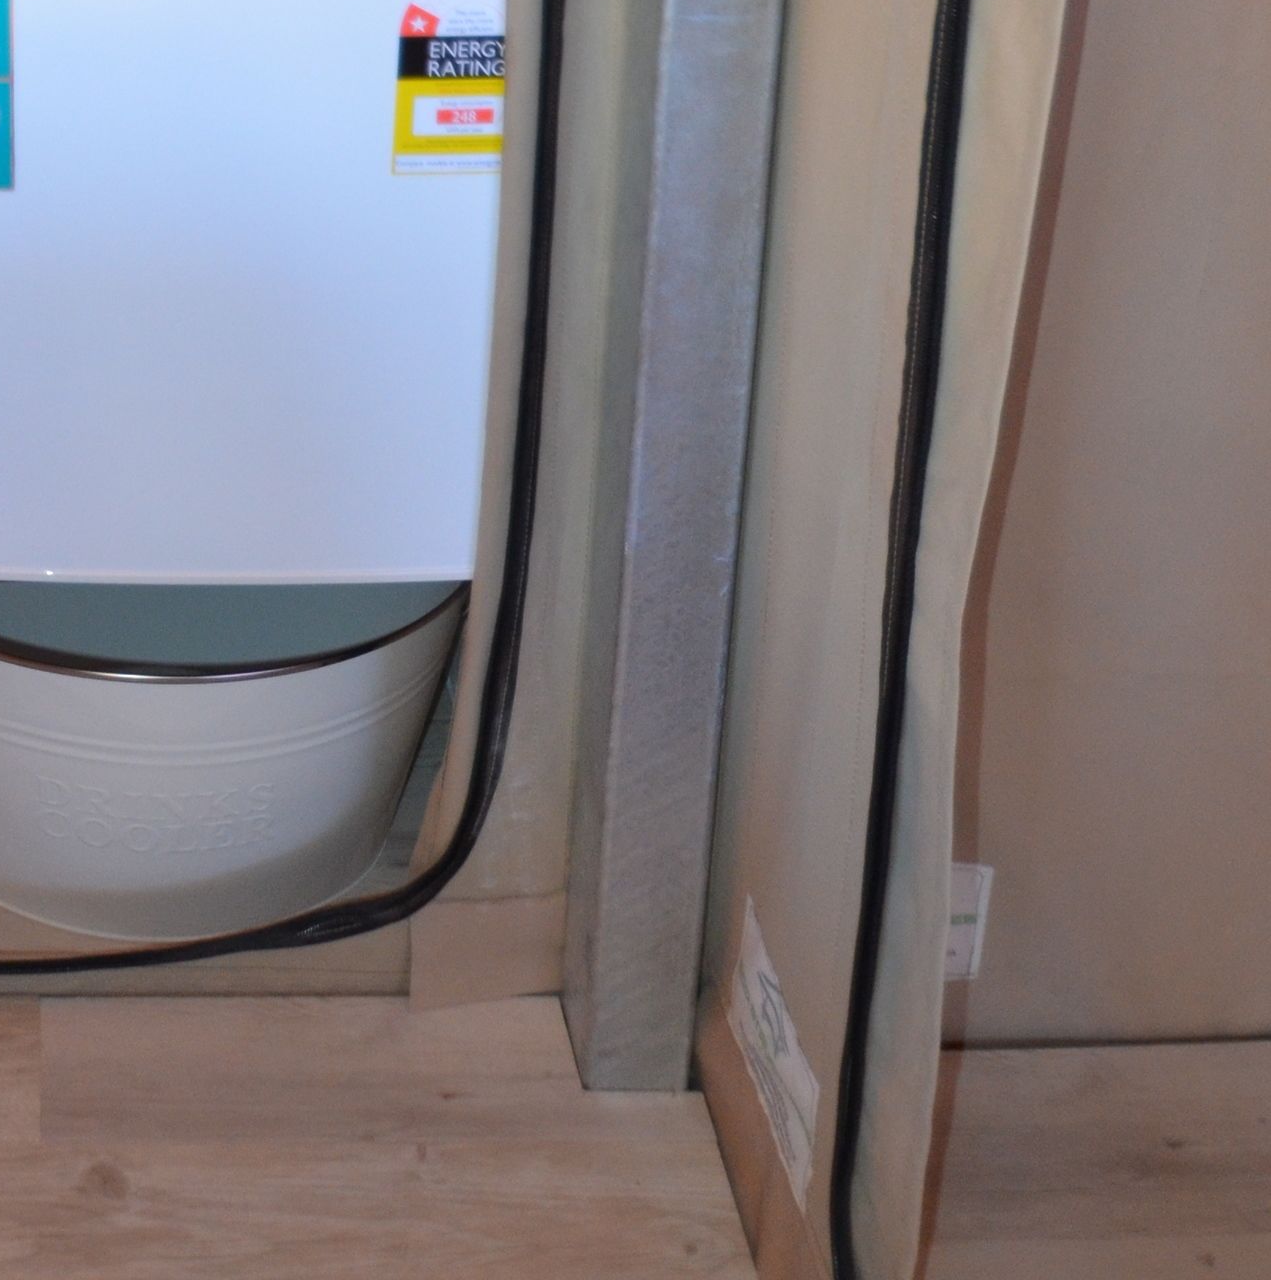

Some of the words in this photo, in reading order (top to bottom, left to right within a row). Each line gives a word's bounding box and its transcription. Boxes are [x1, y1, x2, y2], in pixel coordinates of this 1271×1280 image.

[429, 40, 506, 59] ENERGY
[427, 59, 506, 78] RATING
[36, 774, 275, 821] DRINKS
[38, 808, 275, 853] COOLER
